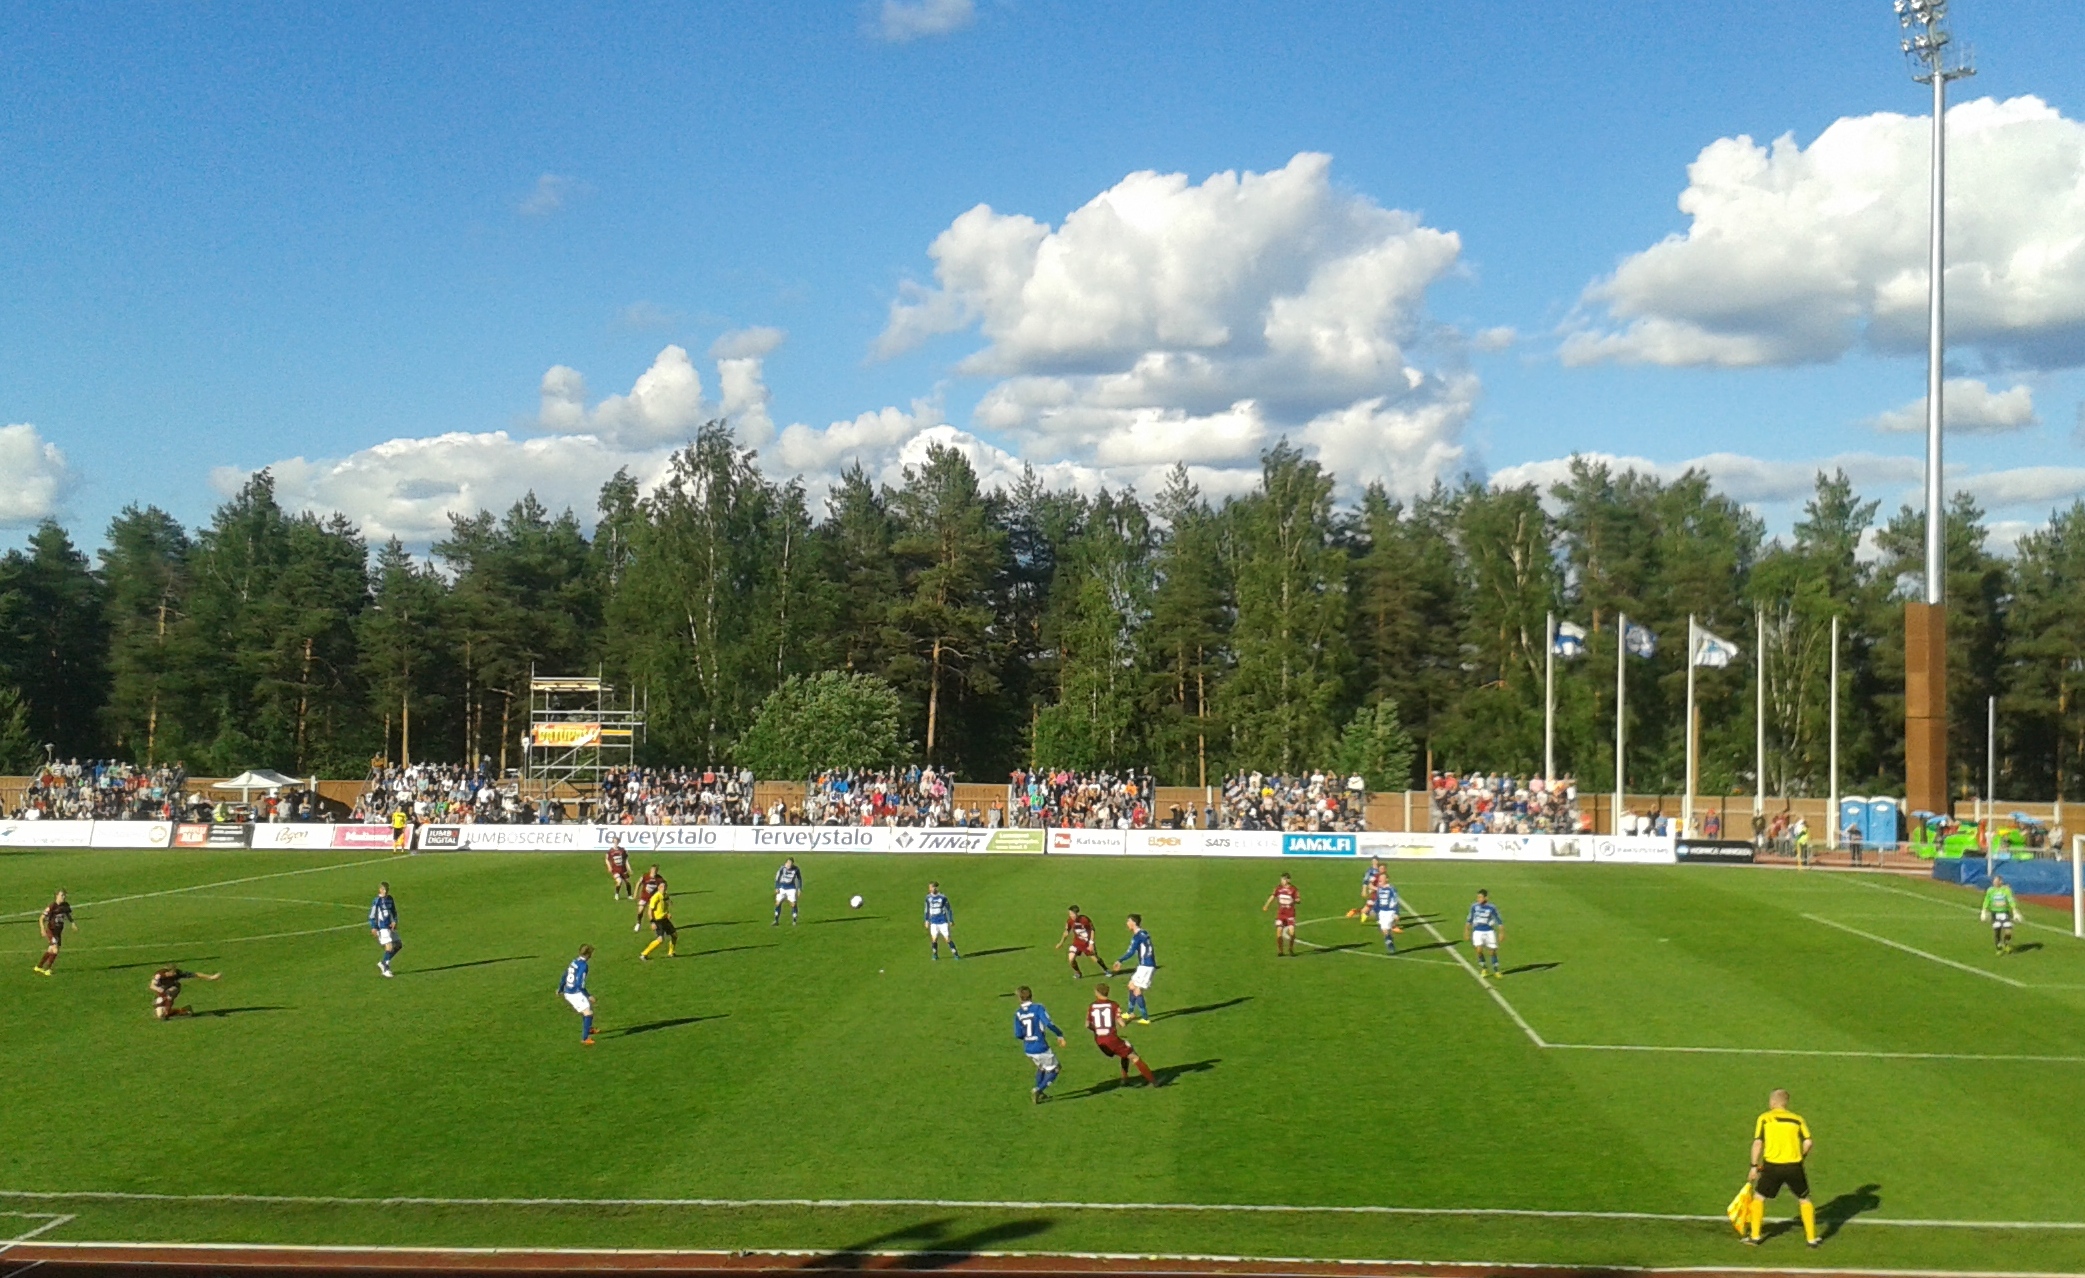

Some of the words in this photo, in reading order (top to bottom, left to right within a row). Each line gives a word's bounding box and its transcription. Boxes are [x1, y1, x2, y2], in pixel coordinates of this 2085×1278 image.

[466, 832, 573, 844] JUMBOSCREEN
[596, 827, 717, 850] Terveystalo
[751, 828, 873, 850] Terveystalo
[1205, 838, 1231, 848] SATS
[1289, 837, 1351, 851] JAMK.FI
[1091, 1007, 1112, 1028] 11
